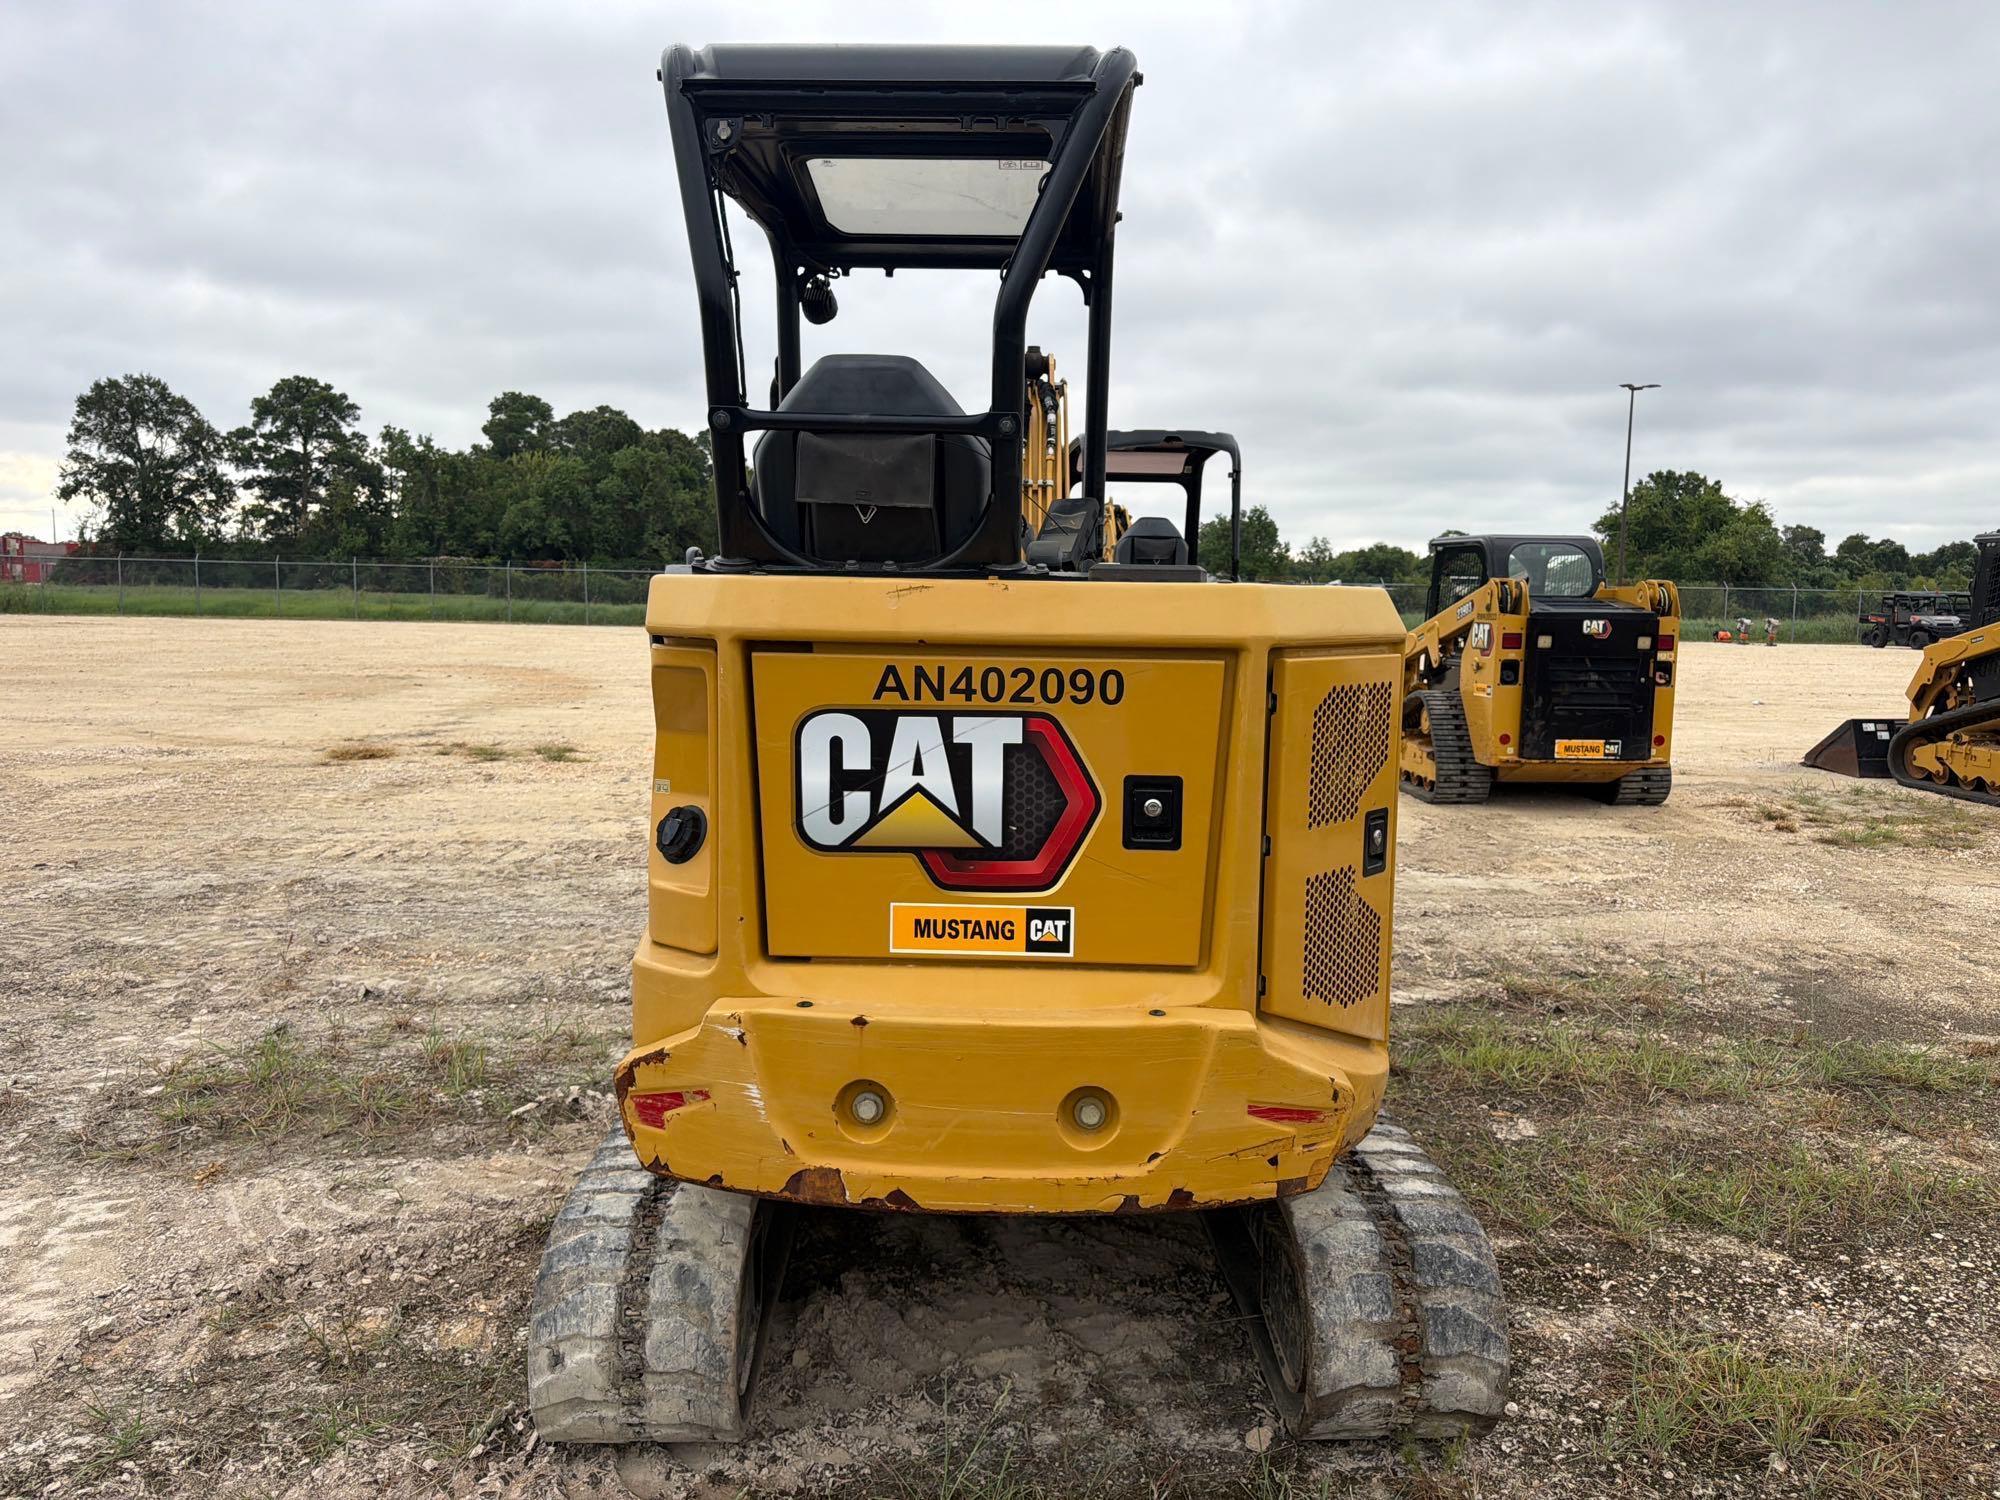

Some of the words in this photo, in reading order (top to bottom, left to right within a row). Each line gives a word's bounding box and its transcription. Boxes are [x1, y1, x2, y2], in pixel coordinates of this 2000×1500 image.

[1472, 622, 1490, 648] CAT
[1583, 619, 1605, 634] CAT
[872, 664, 1125, 705] AN402090
[1563, 745, 1601, 754] MUSTANG
[1605, 744, 1619, 753] CAT
[801, 713, 1023, 848] CAT
[914, 918, 1015, 940] MUSTANG
[1029, 919, 1067, 942] CAT
